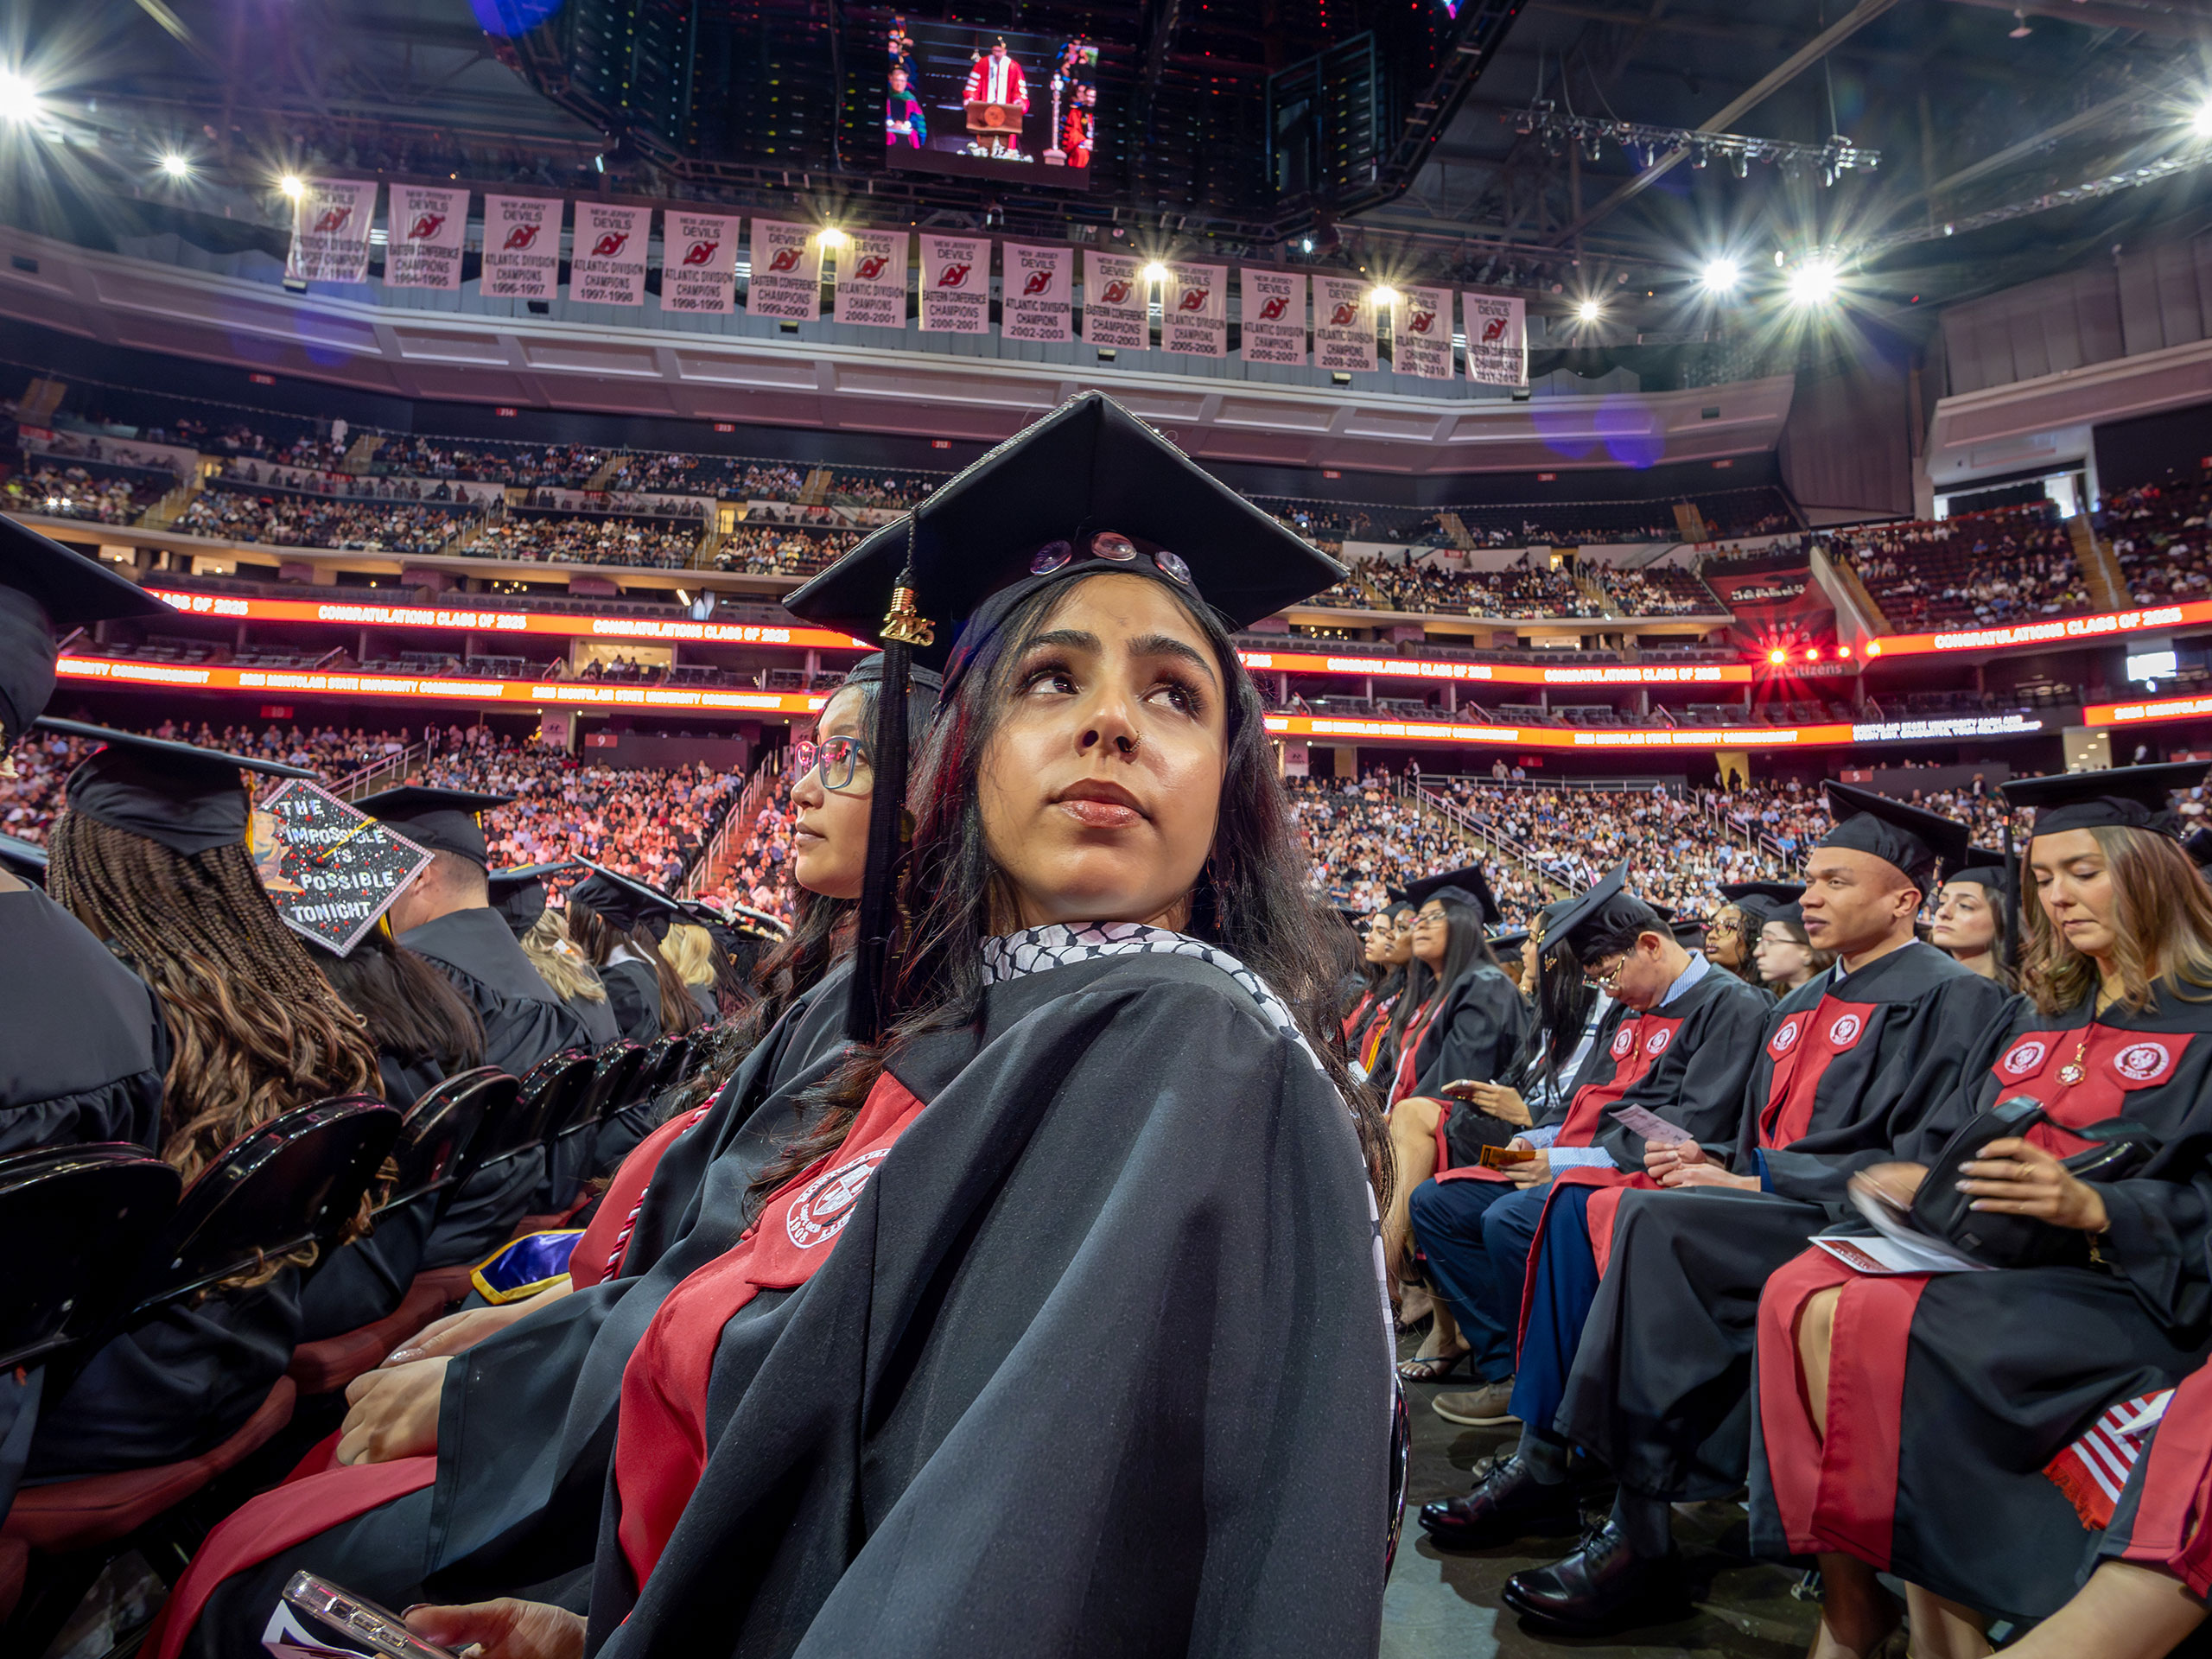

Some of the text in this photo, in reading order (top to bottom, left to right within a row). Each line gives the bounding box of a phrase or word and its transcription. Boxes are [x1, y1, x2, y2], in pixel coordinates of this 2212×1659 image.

[409, 199, 448, 213] DEVILS
[503, 210, 543, 222] DEVILS
[593, 217, 632, 230] DEVILS
[683, 226, 721, 238] DEVILS
[768, 233, 806, 246] DEVILS
[855, 241, 890, 253] DEVILS
[938, 249, 973, 261] DEVILS
[395, 258, 449, 274] CHAMPIONS
[1021, 258, 1055, 270] DEVILS
[1100, 265, 1134, 277] DEVILS
[497, 268, 542, 282] CHAMPIONS
[585, 275, 629, 289] CHAMPIONS
[1178, 274, 1211, 285] DEVILS
[492, 283, 545, 295] 1996-1997
[581, 289, 633, 302] 1997-1998
[677, 283, 721, 298] CHAMPIONS
[1257, 283, 1291, 295] DEVILS
[758, 289, 810, 304] CHAMPIONS
[671, 298, 724, 310] 1998-1999
[758, 302, 809, 317] 1999-2000
[849, 297, 892, 311] CHAMPIONS
[929, 304, 979, 318] CHAMPIONS
[1478, 305, 1510, 317] DEVILS
[845, 311, 895, 324] 2000-2001
[931, 319, 978, 330] 2000-2001
[1016, 313, 1058, 327] CHAMPIONS
[1010, 326, 1064, 339] 2002-2003
[1091, 318, 1141, 334] CHAMPIONS
[1091, 332, 1140, 346] 2002-2003
[1174, 328, 1213, 343] CHAMPIONS
[1255, 336, 1294, 350] CHAMPIONS
[150, 592, 190, 609] ASS
[194, 597, 212, 612] OF
[319, 606, 435, 625] CONGRATULATIONS
[437, 613, 476, 626] CLASS
[479, 614, 494, 627] OF
[593, 620, 702, 638] CONGRATULATIONS
[705, 626, 742, 639] CLASS
[744, 628, 760, 640] OF
[1935, 607, 2182, 648] CONGRATULATIONS CLASS OF 2025
[1327, 658, 1420, 675] CONGRATULATIONS
[1421, 664, 1452, 677] CLASS
[1453, 665, 1466, 677] OF
[1786, 663, 1842, 677] Citizens
[1545, 669, 1641, 682] CONGRATULATIONS
[1643, 669, 1677, 680] CLASS
[1679, 668, 1693, 680] OF
[267, 675, 326, 688] MONTCLAIR
[327, 677, 359, 690] STATE
[360, 679, 418, 692] UNIVERSITY
[558, 688, 613, 700] MONTCLAIR
[615, 690, 644, 702] STATE
[646, 691, 701, 703] UNIVERSITY
[598, 734, 606, 747] 9
[278, 799, 324, 817] THE
[285, 827, 387, 844] IMPOSSIBLE
[334, 849, 353, 863] IS
[300, 871, 396, 891] POSSIBLE
[290, 901, 371, 923] TONIGHT
[790, 1217, 809, 1243] 1908
